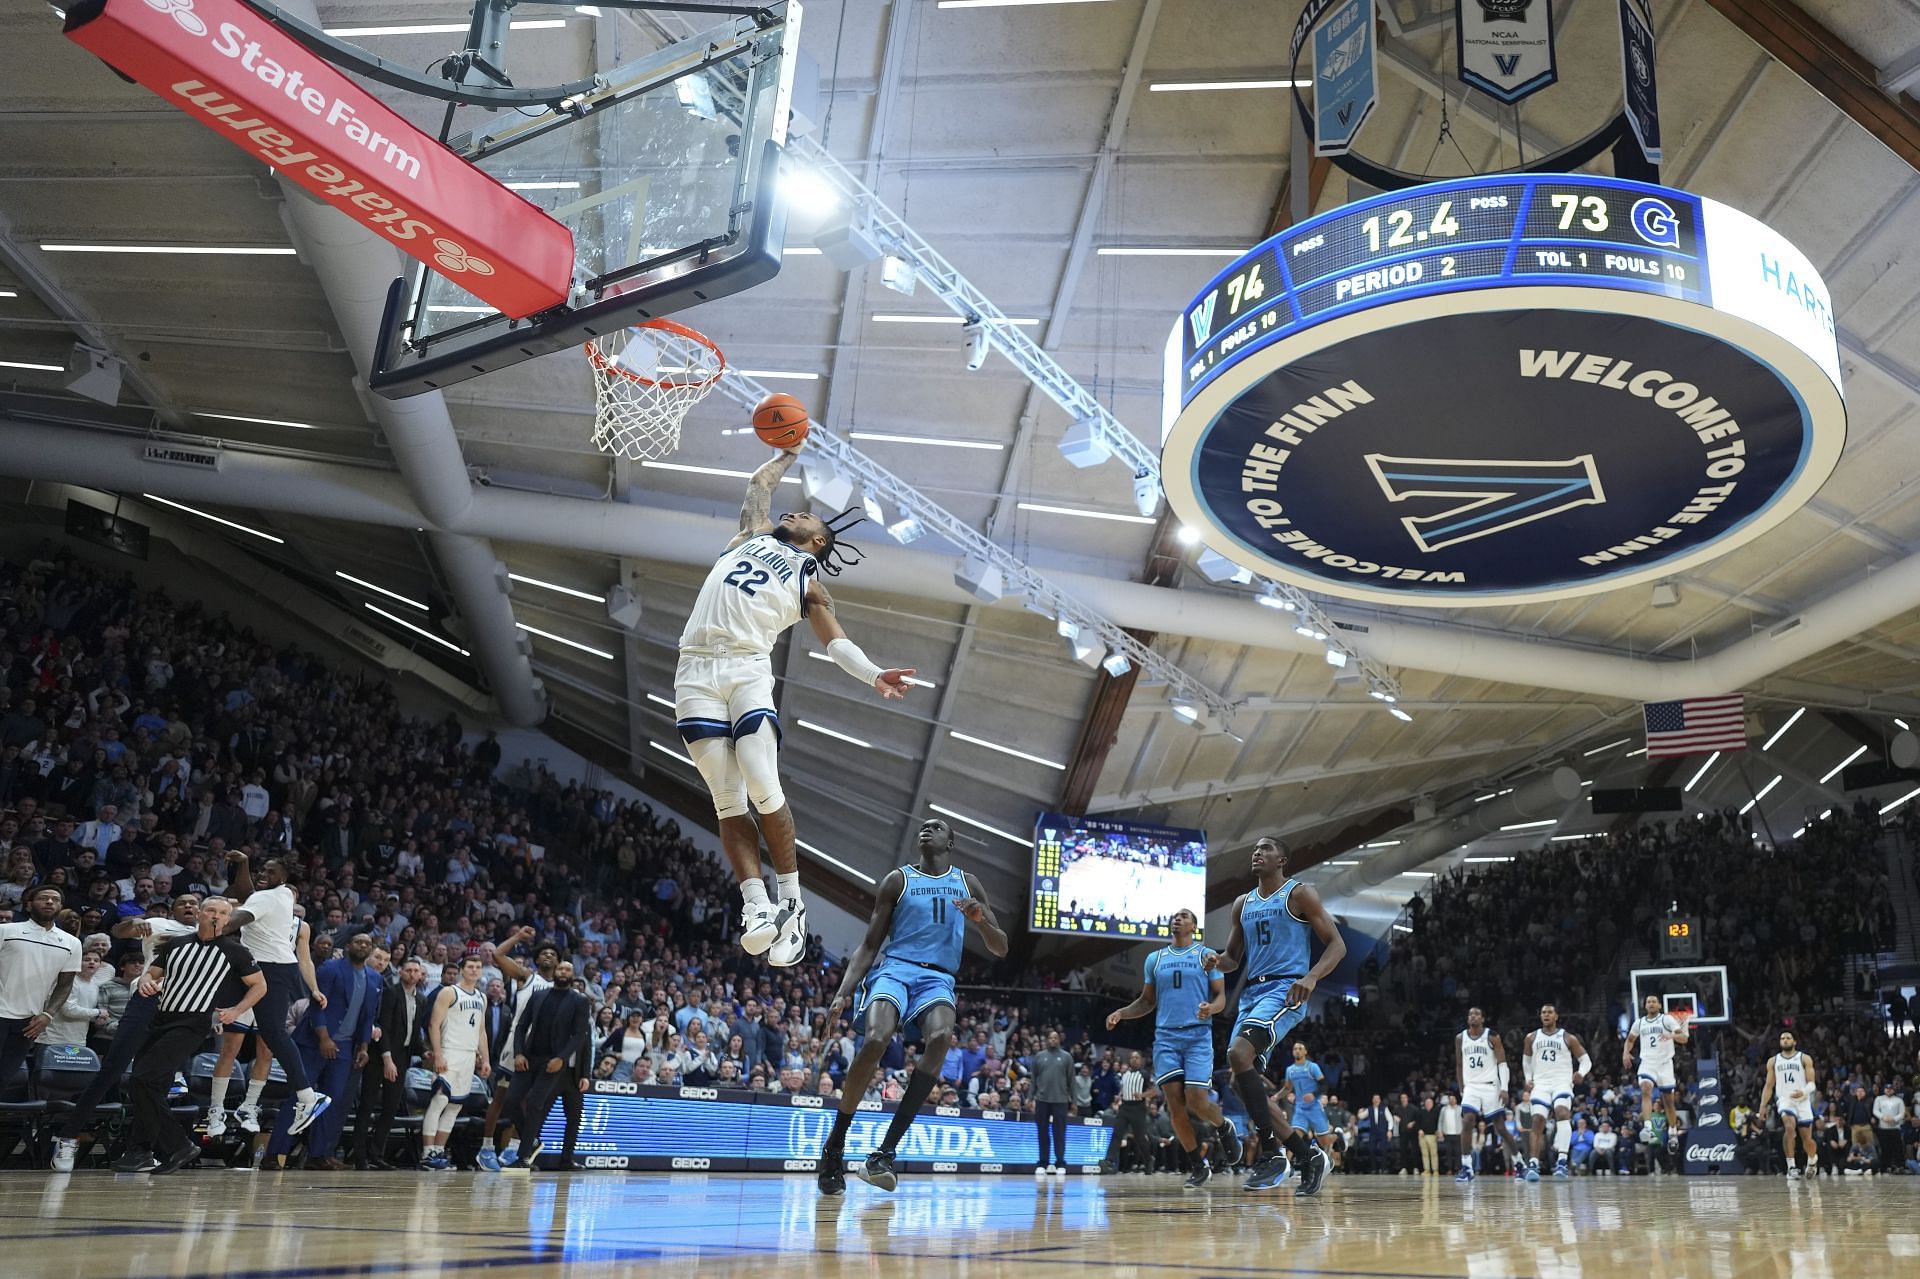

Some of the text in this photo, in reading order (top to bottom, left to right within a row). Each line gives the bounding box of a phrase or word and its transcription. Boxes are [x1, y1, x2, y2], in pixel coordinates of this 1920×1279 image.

[1491, 31, 1519, 39] NCAA
[1293, 195, 1508, 256] POSS 12.4 POSS
[1551, 194, 1681, 249] 73 G
[1336, 256, 1456, 301] PERIOD 2
[1535, 250, 1685, 281] TOL 1 FOULS 10
[1227, 263, 1265, 315] 74
[1189, 358, 1206, 381] TOL
[1221, 321, 1257, 355] FOULS
[1260, 310, 1277, 329] 10
[1519, 349, 1746, 567] WELCOME TO THE FINN
[1241, 379, 1466, 583] WELCOME TO THE FINN
[723, 560, 770, 597] 22
[911, 886, 964, 899] GEORGETOWN
[932, 896, 946, 925] 11
[1244, 908, 1283, 921] GEORGETOWN
[1255, 920, 1271, 946] 15
[1160, 961, 1197, 971] GEORGETOWN
[1173, 970, 1182, 989] 0
[468, 1013, 476, 1027] 4
[1649, 1036, 1657, 1047] 2
[1469, 1056, 1484, 1069] 34
[1541, 1049, 1556, 1062] 43
[1784, 1072, 1795, 1084] 14
[595, 1080, 638, 1094] GEICO
[679, 1086, 718, 1100] GEICO
[791, 1095, 824, 1107] GEICO
[935, 1106, 961, 1117] GEICO
[982, 1111, 1005, 1120] GEICO
[585, 1156, 629, 1169] GEICO
[671, 1157, 711, 1169] GEICO
[783, 1160, 817, 1171] GEICO
[932, 1162, 958, 1173] GEICO
[980, 1163, 1003, 1173] GEICO
